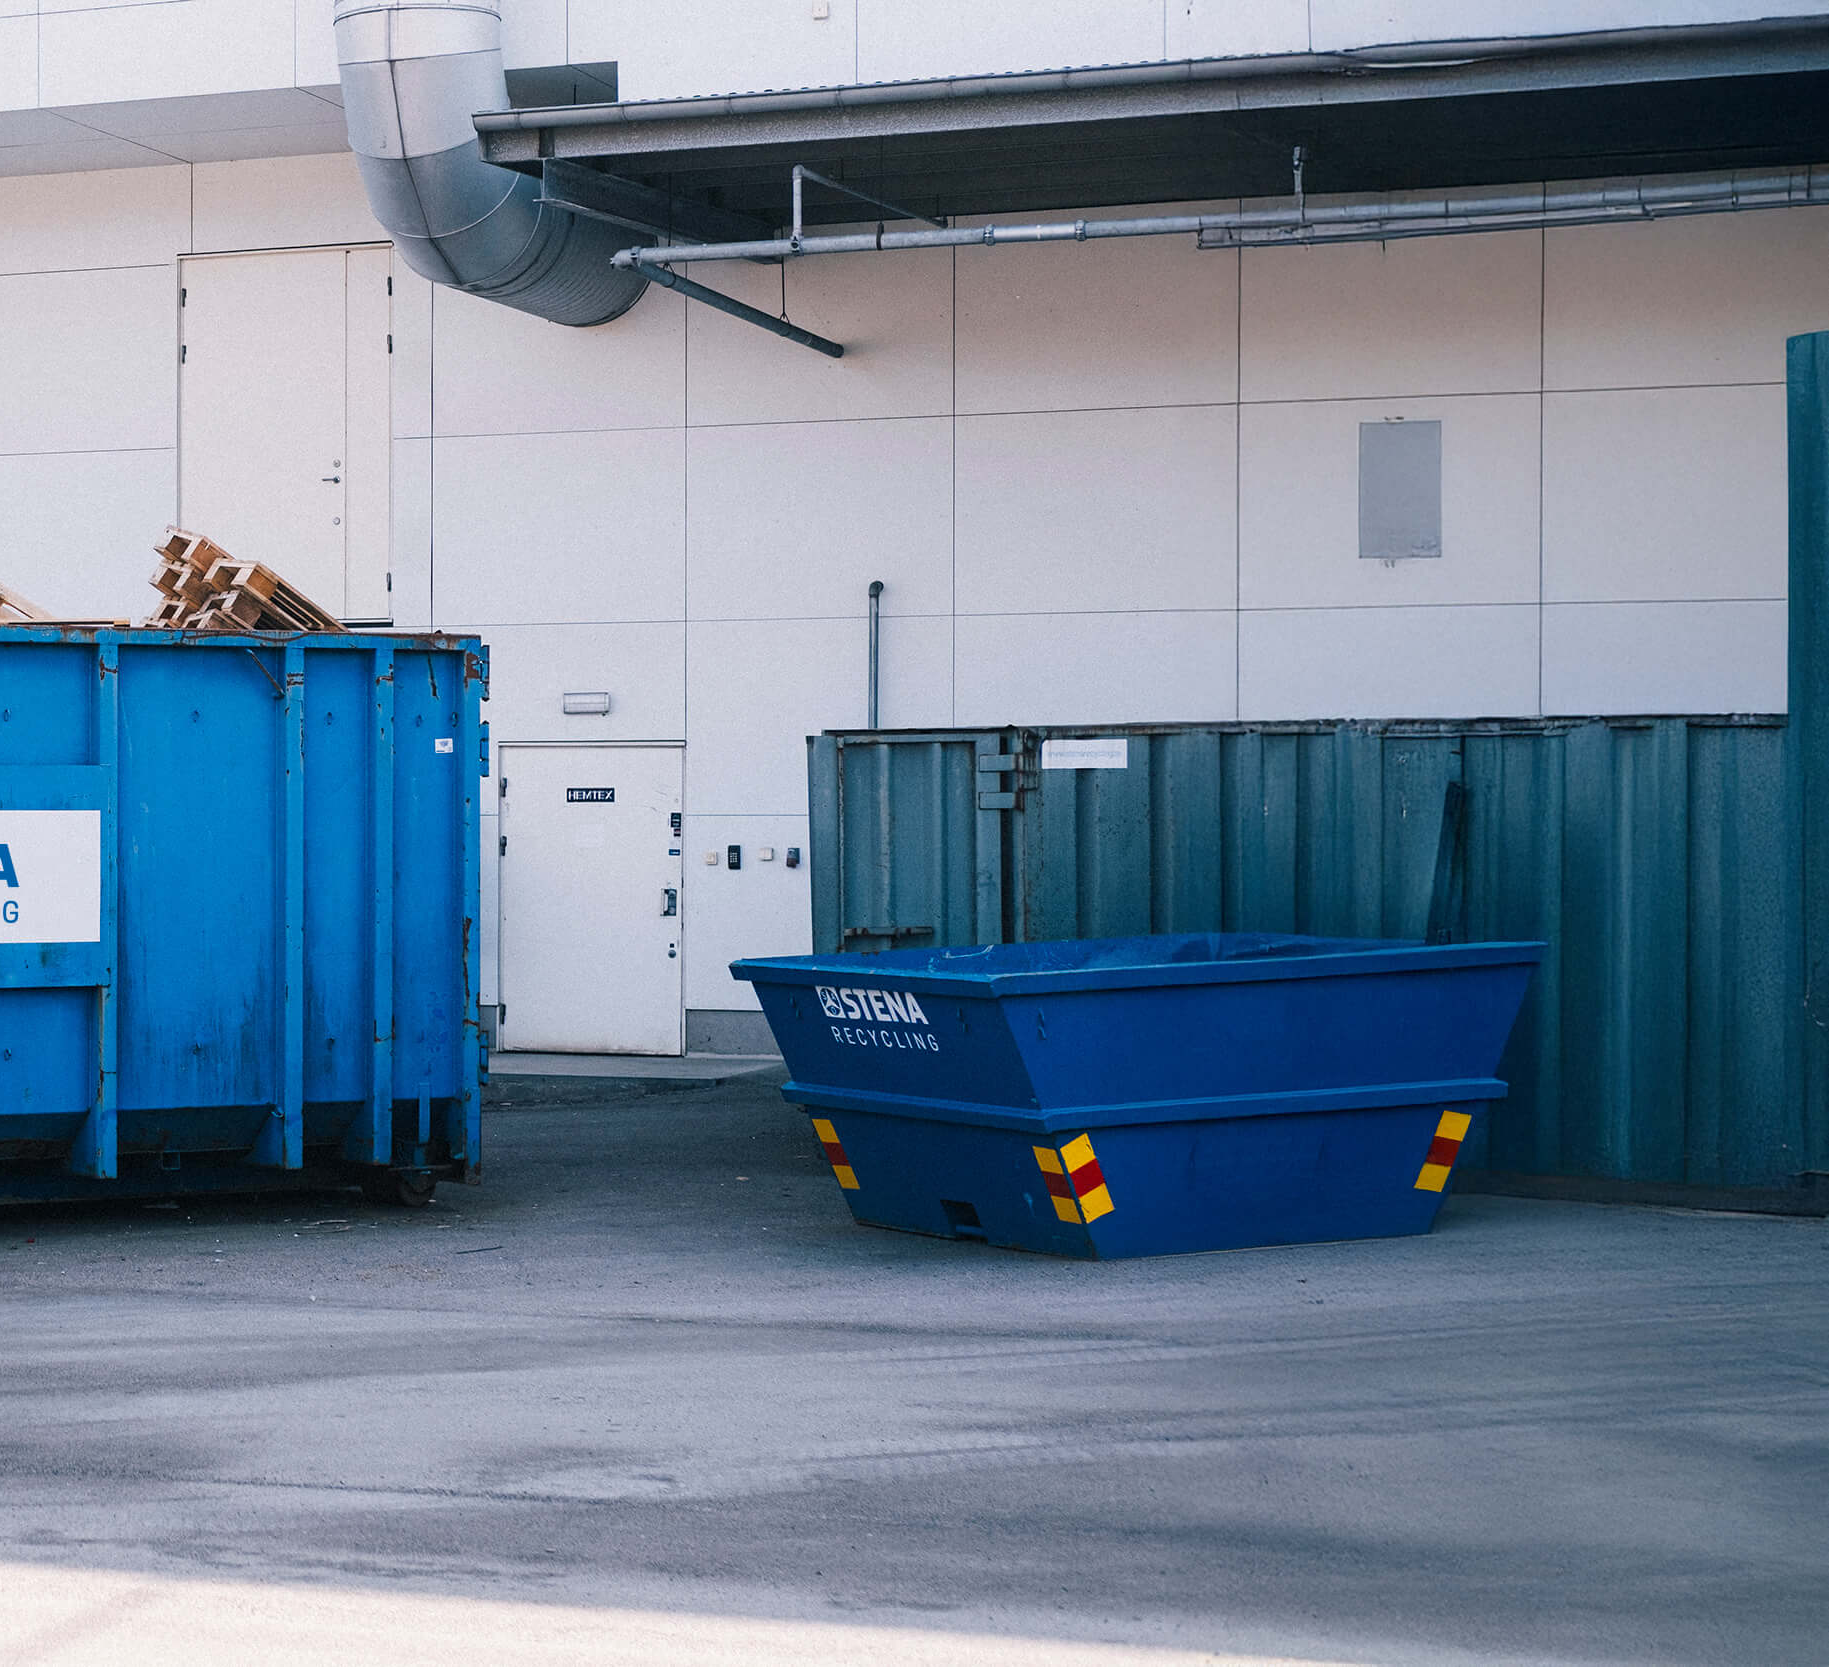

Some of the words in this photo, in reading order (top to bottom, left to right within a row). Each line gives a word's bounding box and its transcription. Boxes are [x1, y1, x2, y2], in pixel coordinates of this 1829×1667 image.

[568, 790, 613, 800] HEMTEX
[839, 988, 929, 1025] STENA
[831, 1026, 939, 1051] RECYCLING
